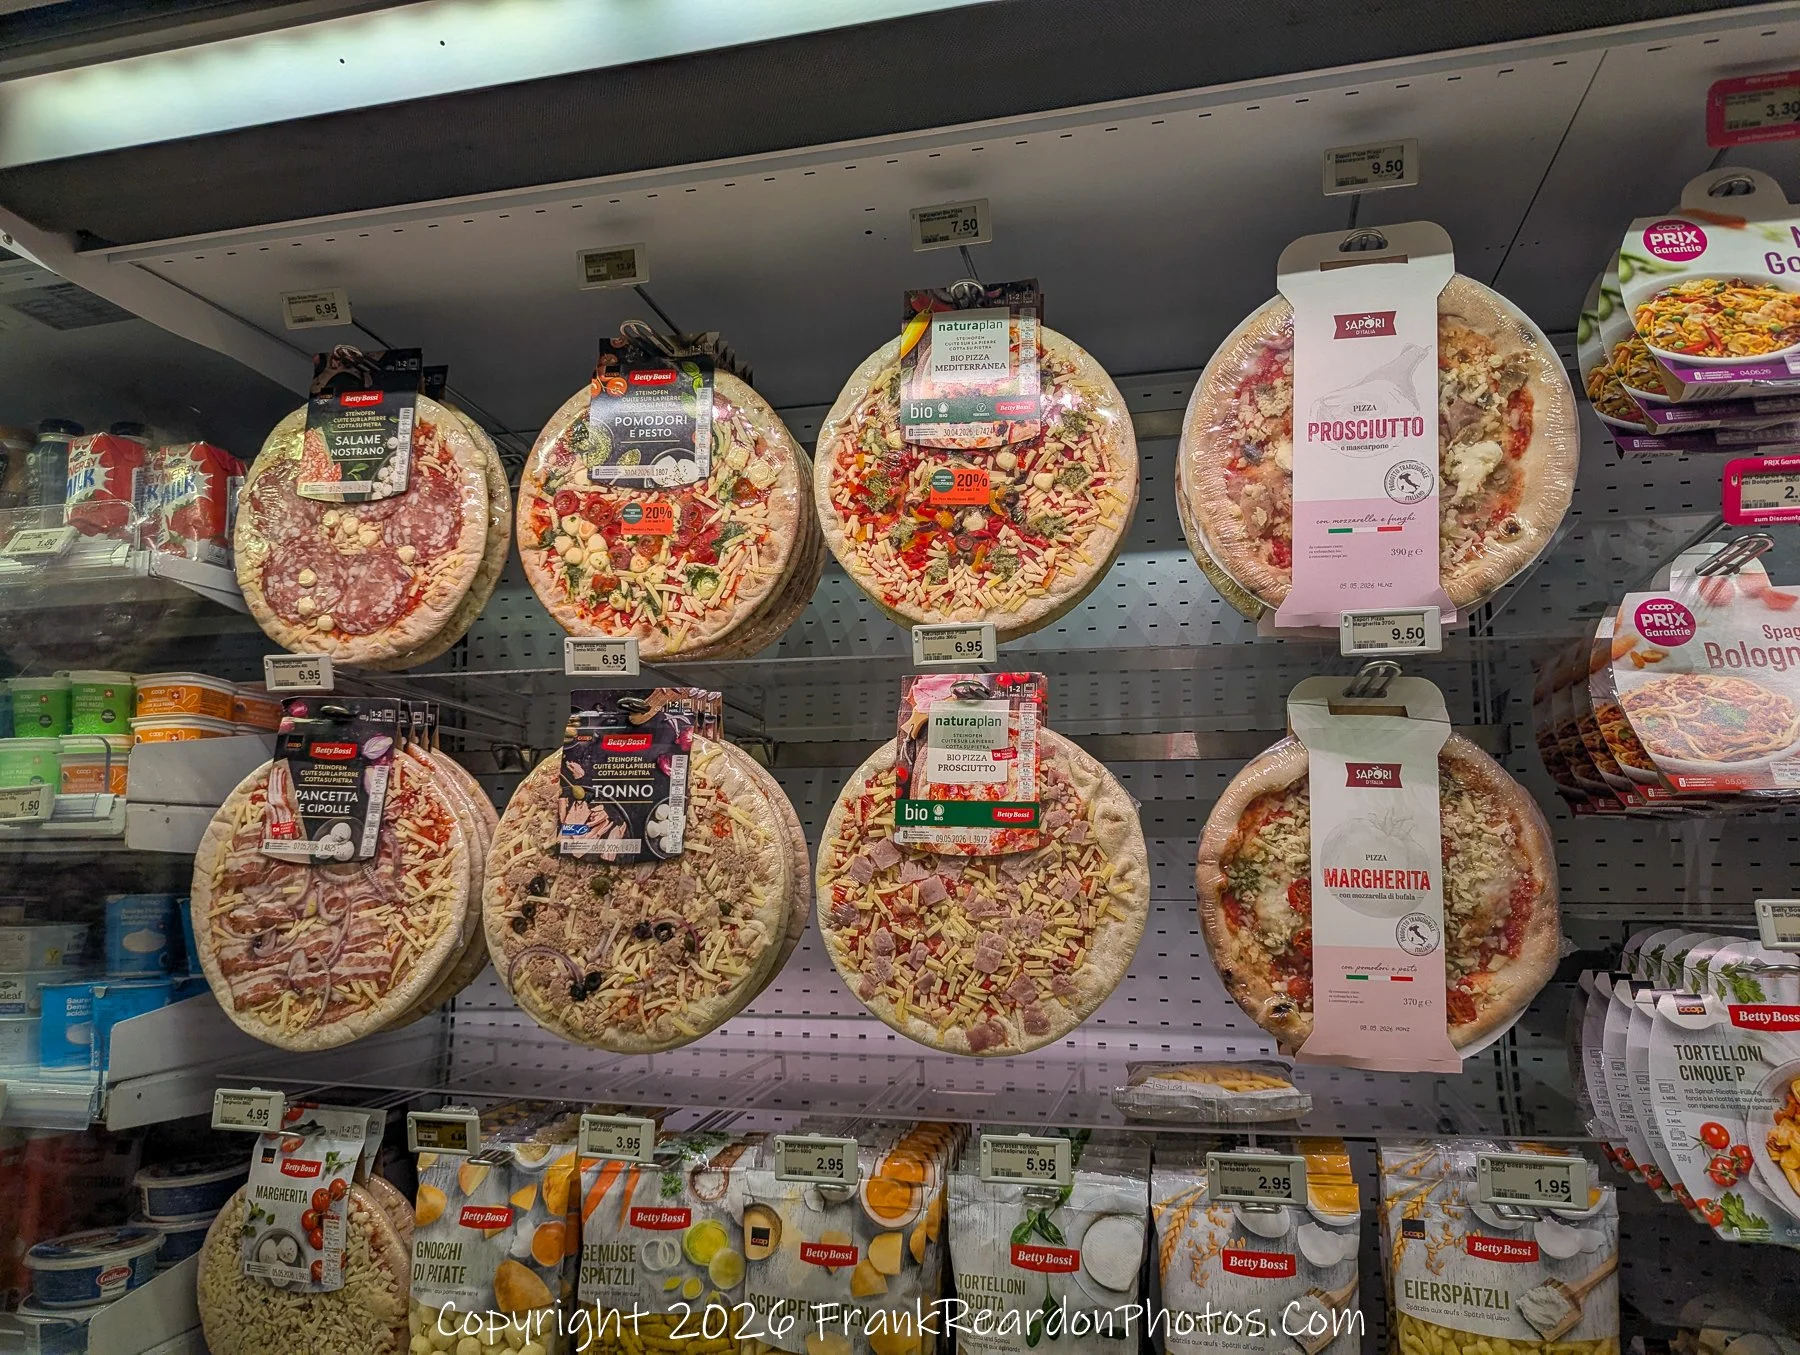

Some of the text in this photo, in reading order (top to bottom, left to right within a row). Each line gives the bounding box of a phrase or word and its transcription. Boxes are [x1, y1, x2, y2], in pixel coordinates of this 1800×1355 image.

[1766, 101, 1800, 117] 3.30
[1372, 159, 1403, 174] 9.50
[951, 218, 978, 233] 7.50
[1656, 223, 1685, 231] coop
[1653, 244, 1702, 254] Garantie
[315, 303, 337, 316] 6.95
[938, 320, 1003, 333] naturaplan
[1345, 315, 1385, 331] SAPORI
[935, 362, 1007, 372] MEDITERRANEA
[634, 372, 672, 382] Betty Bossi
[910, 403, 933, 419] bio
[1353, 404, 1377, 412] PIZZA
[615, 415, 687, 426] POMODORI
[638, 428, 672, 438] PESTO
[1308, 416, 1424, 442] PROSCIUTTO
[335, 435, 381, 446] SALAME
[331, 447, 385, 457] NOSTRANO
[957, 473, 988, 487] 20%
[646, 506, 672, 519] 20%
[1646, 604, 1674, 612] coop
[1391, 627, 1425, 640] 9.50
[1644, 628, 1691, 637] Garantie
[955, 640, 982, 653] 6.95
[602, 654, 626, 665] 6.95
[298, 670, 321, 680] 6.95
[935, 715, 1002, 729] naturaplan
[607, 739, 626, 747] Betty
[315, 747, 333, 755] Betty
[962, 754, 988, 762] PIZZA
[937, 764, 996, 772] PROSCIUTTO
[1355, 767, 1392, 780] SAPORI
[295, 790, 359, 802] PANCETTA
[592, 784, 654, 798] TONNO
[20, 800, 40, 814] 1.50
[298, 803, 350, 814] E CIPOLLE
[905, 804, 928, 821] bio
[997, 811, 1013, 819] Betty
[1365, 854, 1388, 862] PIZZA
[1323, 868, 1431, 891] MARGHERITA
[1352, 892, 1387, 900] mozzarella
[1678, 1006, 1705, 1014] coop
[1739, 1010, 1771, 1024] Betty
[1673, 1045, 1764, 1062] TORTELLONI
[1679, 1065, 1746, 1084] CINQUE P
[246, 1108, 269, 1120] 4.95
[616, 1136, 640, 1149] 3.95
[285, 1163, 317, 1173] Betty Bossi
[816, 1157, 844, 1171] 2.95
[1026, 1158, 1056, 1171] 5.95
[1258, 1176, 1291, 1190] 2.95
[1534, 1178, 1570, 1194] 1.95
[255, 1185, 308, 1204] MARGHERITA
[462, 1211, 508, 1222] Betty Bossi
[636, 1212, 686, 1224] Betty Bossi
[1403, 1230, 1425, 1239] coop
[416, 1240, 463, 1261] GNOCCHI
[582, 1240, 637, 1263] GEMÜSE
[806, 1247, 853, 1260] Betty Bossi
[1474, 1242, 1532, 1256] Betty Bossi
[1018, 1251, 1073, 1267] Betty Bossi
[1229, 1256, 1289, 1271] Betty Bossi
[413, 1263, 467, 1284] DI PATATE
[581, 1263, 635, 1286] SPÄTZLI
[958, 1273, 1026, 1296] TORTELLONI
[1404, 1279, 1510, 1311] EIERSPÄTZLI
[958, 1292, 1004, 1313] RICOTTA
[1406, 1303, 1430, 1313] Spätzlis
[1443, 1308, 1460, 1316] œufs
[1463, 1310, 1486, 1319] Spätzli
[1486, 1313, 1510, 1322] all'uovo
